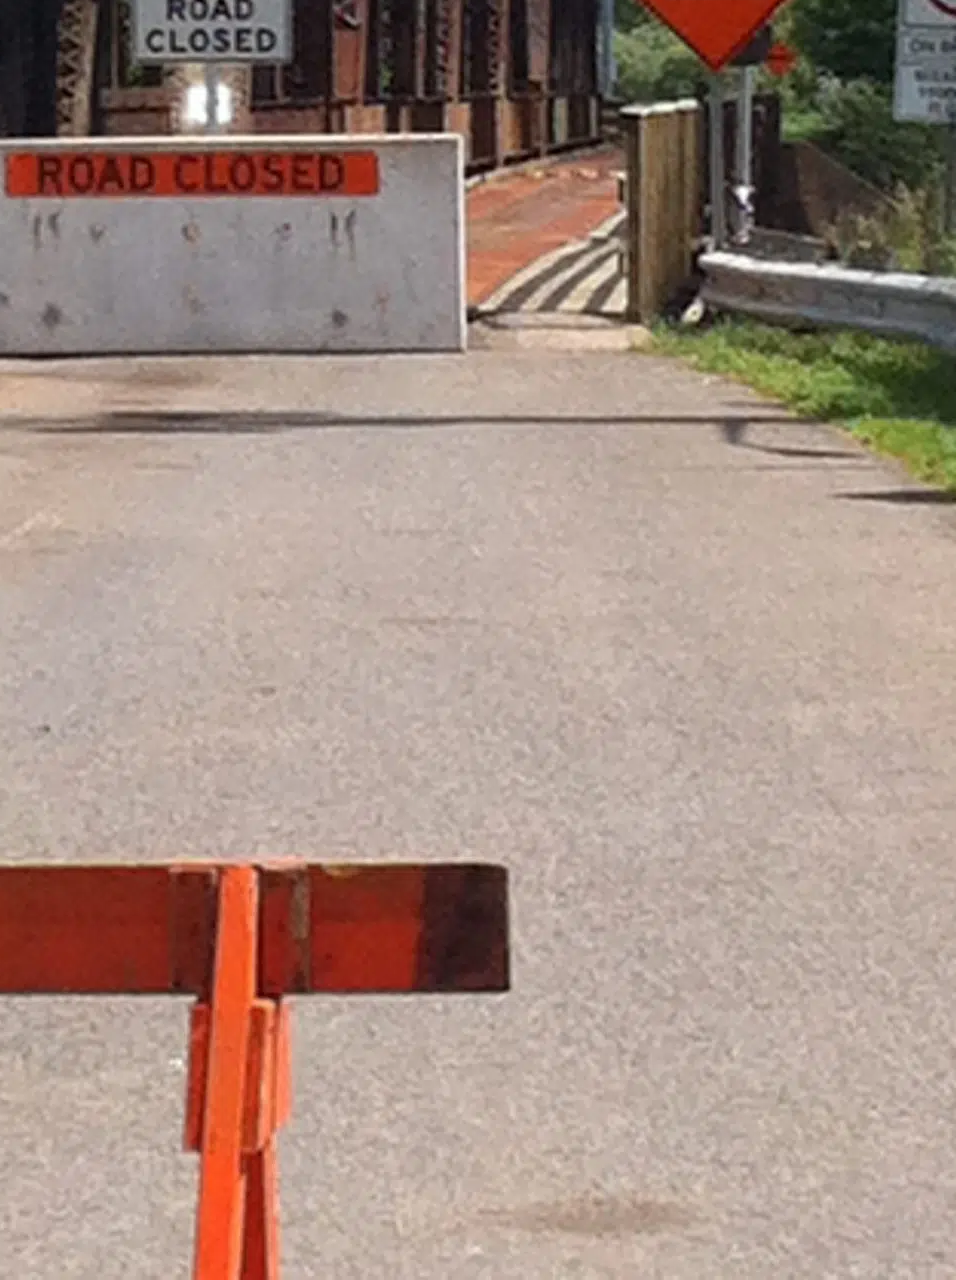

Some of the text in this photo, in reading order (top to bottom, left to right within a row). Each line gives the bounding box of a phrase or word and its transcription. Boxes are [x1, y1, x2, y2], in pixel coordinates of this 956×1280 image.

[145, 28, 277, 53] CLOSED
[38, 152, 344, 195] ROAD CLOSED
